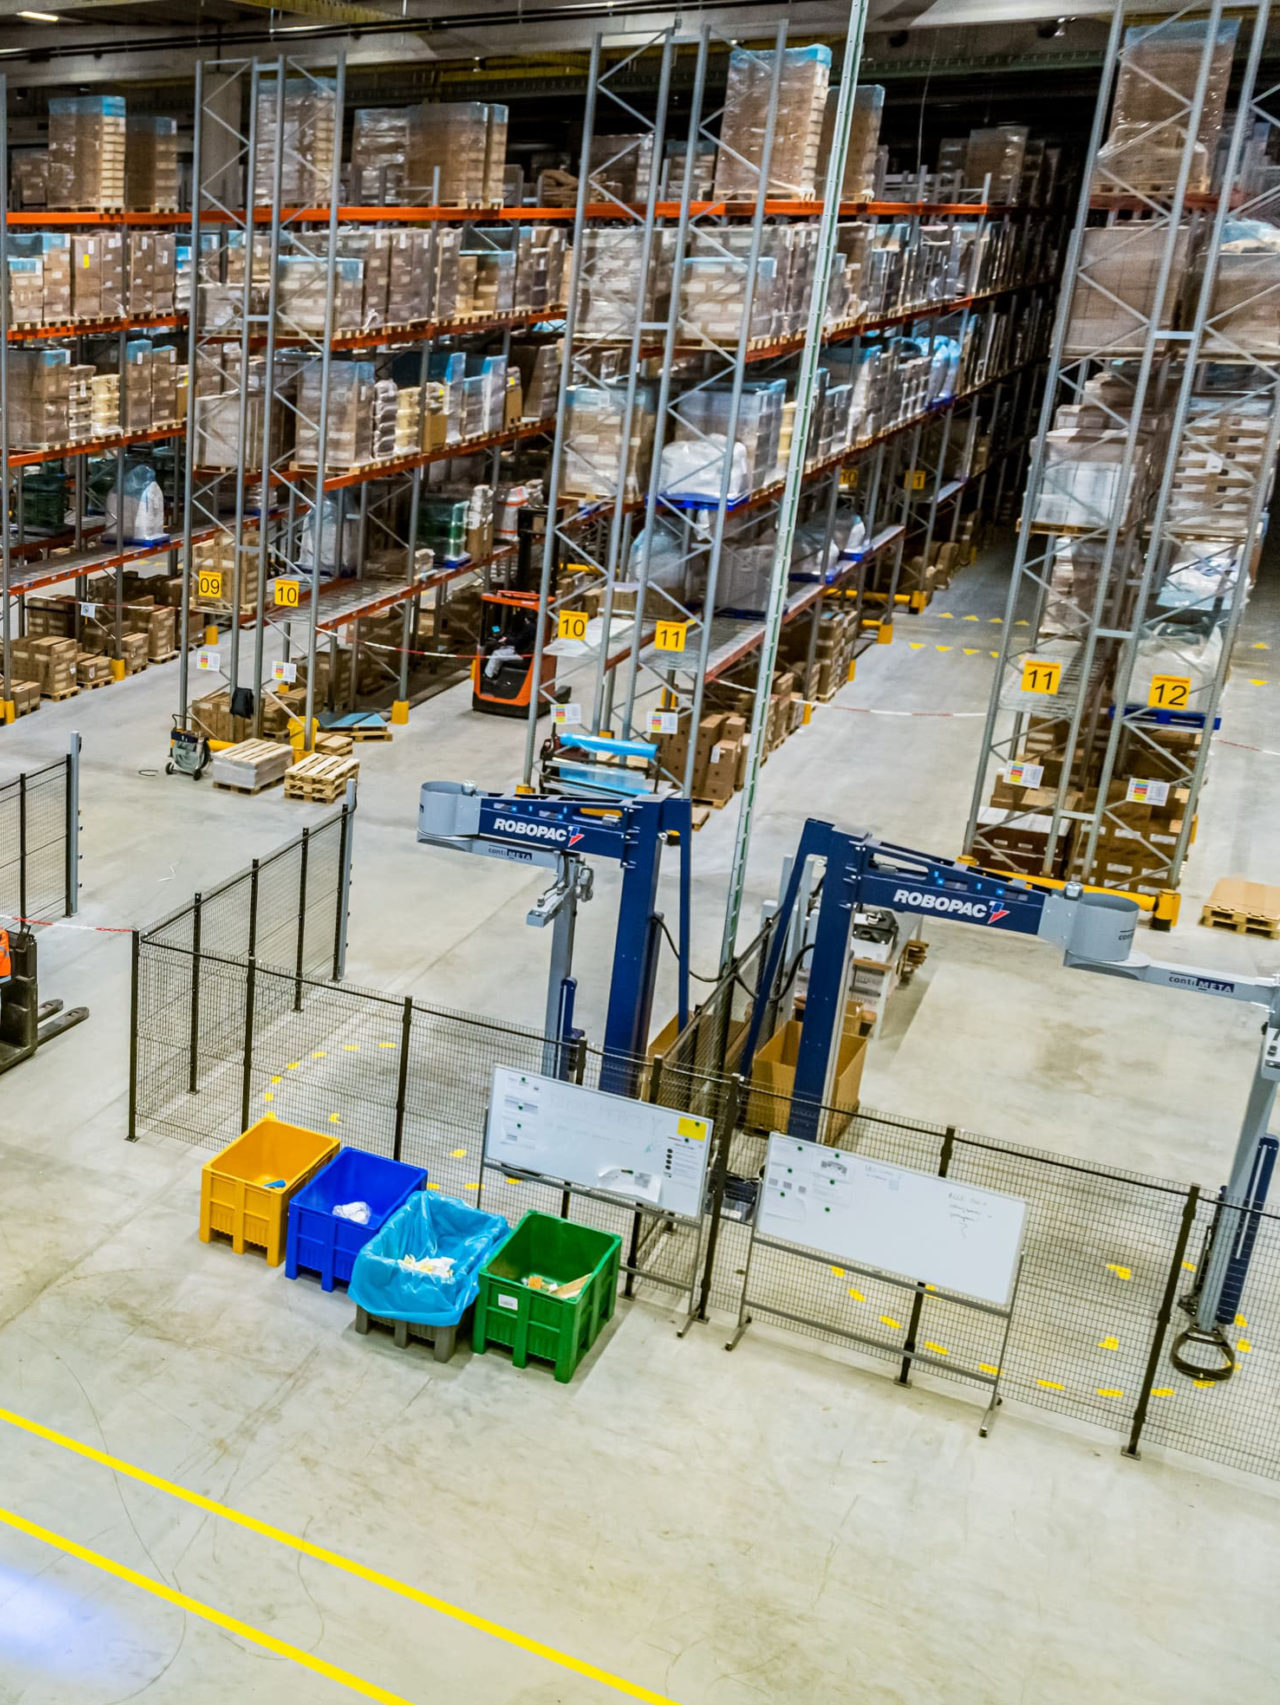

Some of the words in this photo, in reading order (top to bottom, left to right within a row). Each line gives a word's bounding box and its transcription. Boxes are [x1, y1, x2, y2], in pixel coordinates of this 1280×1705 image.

[200, 577, 220, 595] 09
[277, 586, 298, 604] 10
[561, 618, 586, 637] 10
[659, 628, 681, 649] 11
[1028, 668, 1054, 691] 11
[1154, 683, 1188, 707] 12
[493, 817, 567, 842] ROBOPAC
[893, 889, 988, 918] ROBOPAC
[1168, 975, 1235, 994] contiMETA
